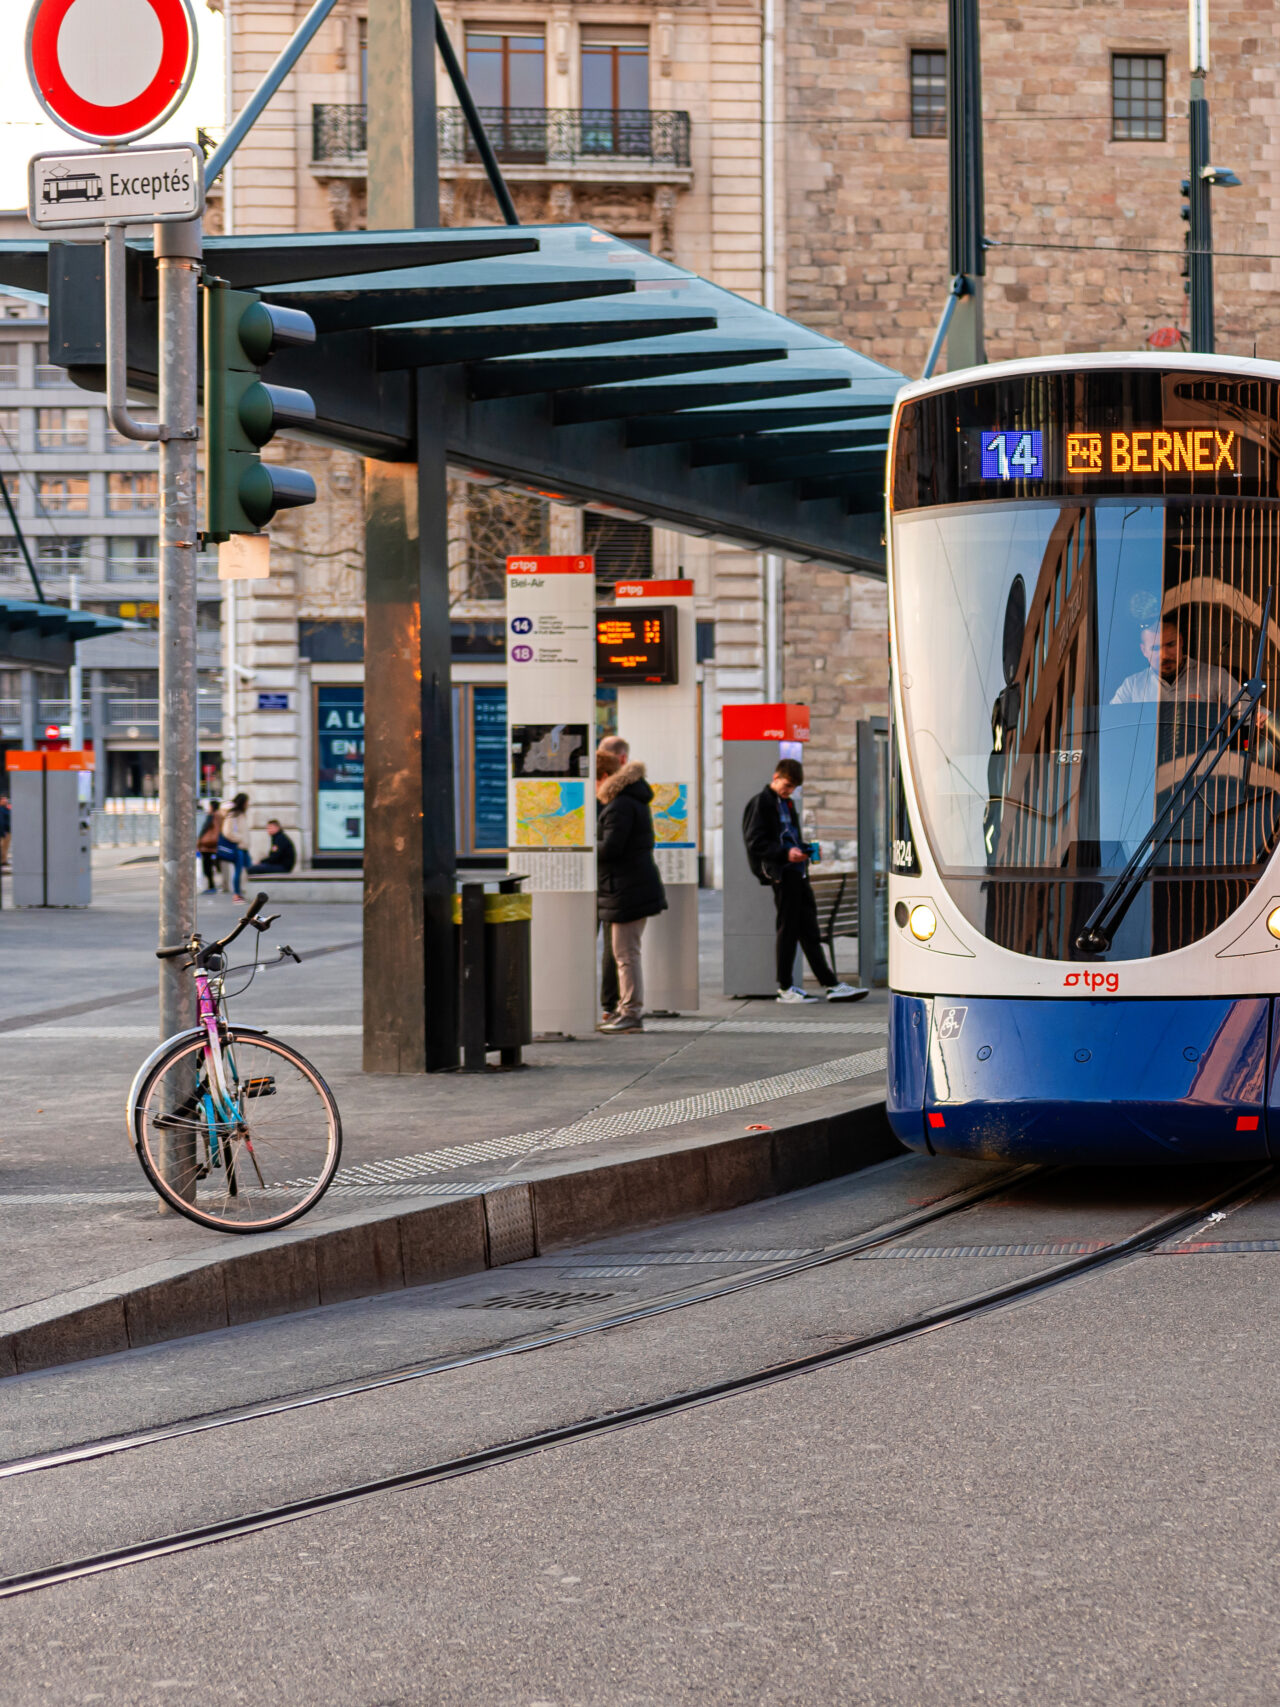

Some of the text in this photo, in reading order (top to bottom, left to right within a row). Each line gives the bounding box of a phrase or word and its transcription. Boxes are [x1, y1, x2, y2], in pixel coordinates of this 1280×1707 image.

[110, 168, 190, 200] Exceptés
[987, 431, 1234, 475] 14 P+R BERNEX
[511, 579, 544, 588] Bel-Air
[514, 620, 529, 631] 14
[515, 648, 530, 660] 18
[326, 710, 343, 728] A
[331, 740, 357, 755] EN
[1083, 970, 1119, 992] tpg
